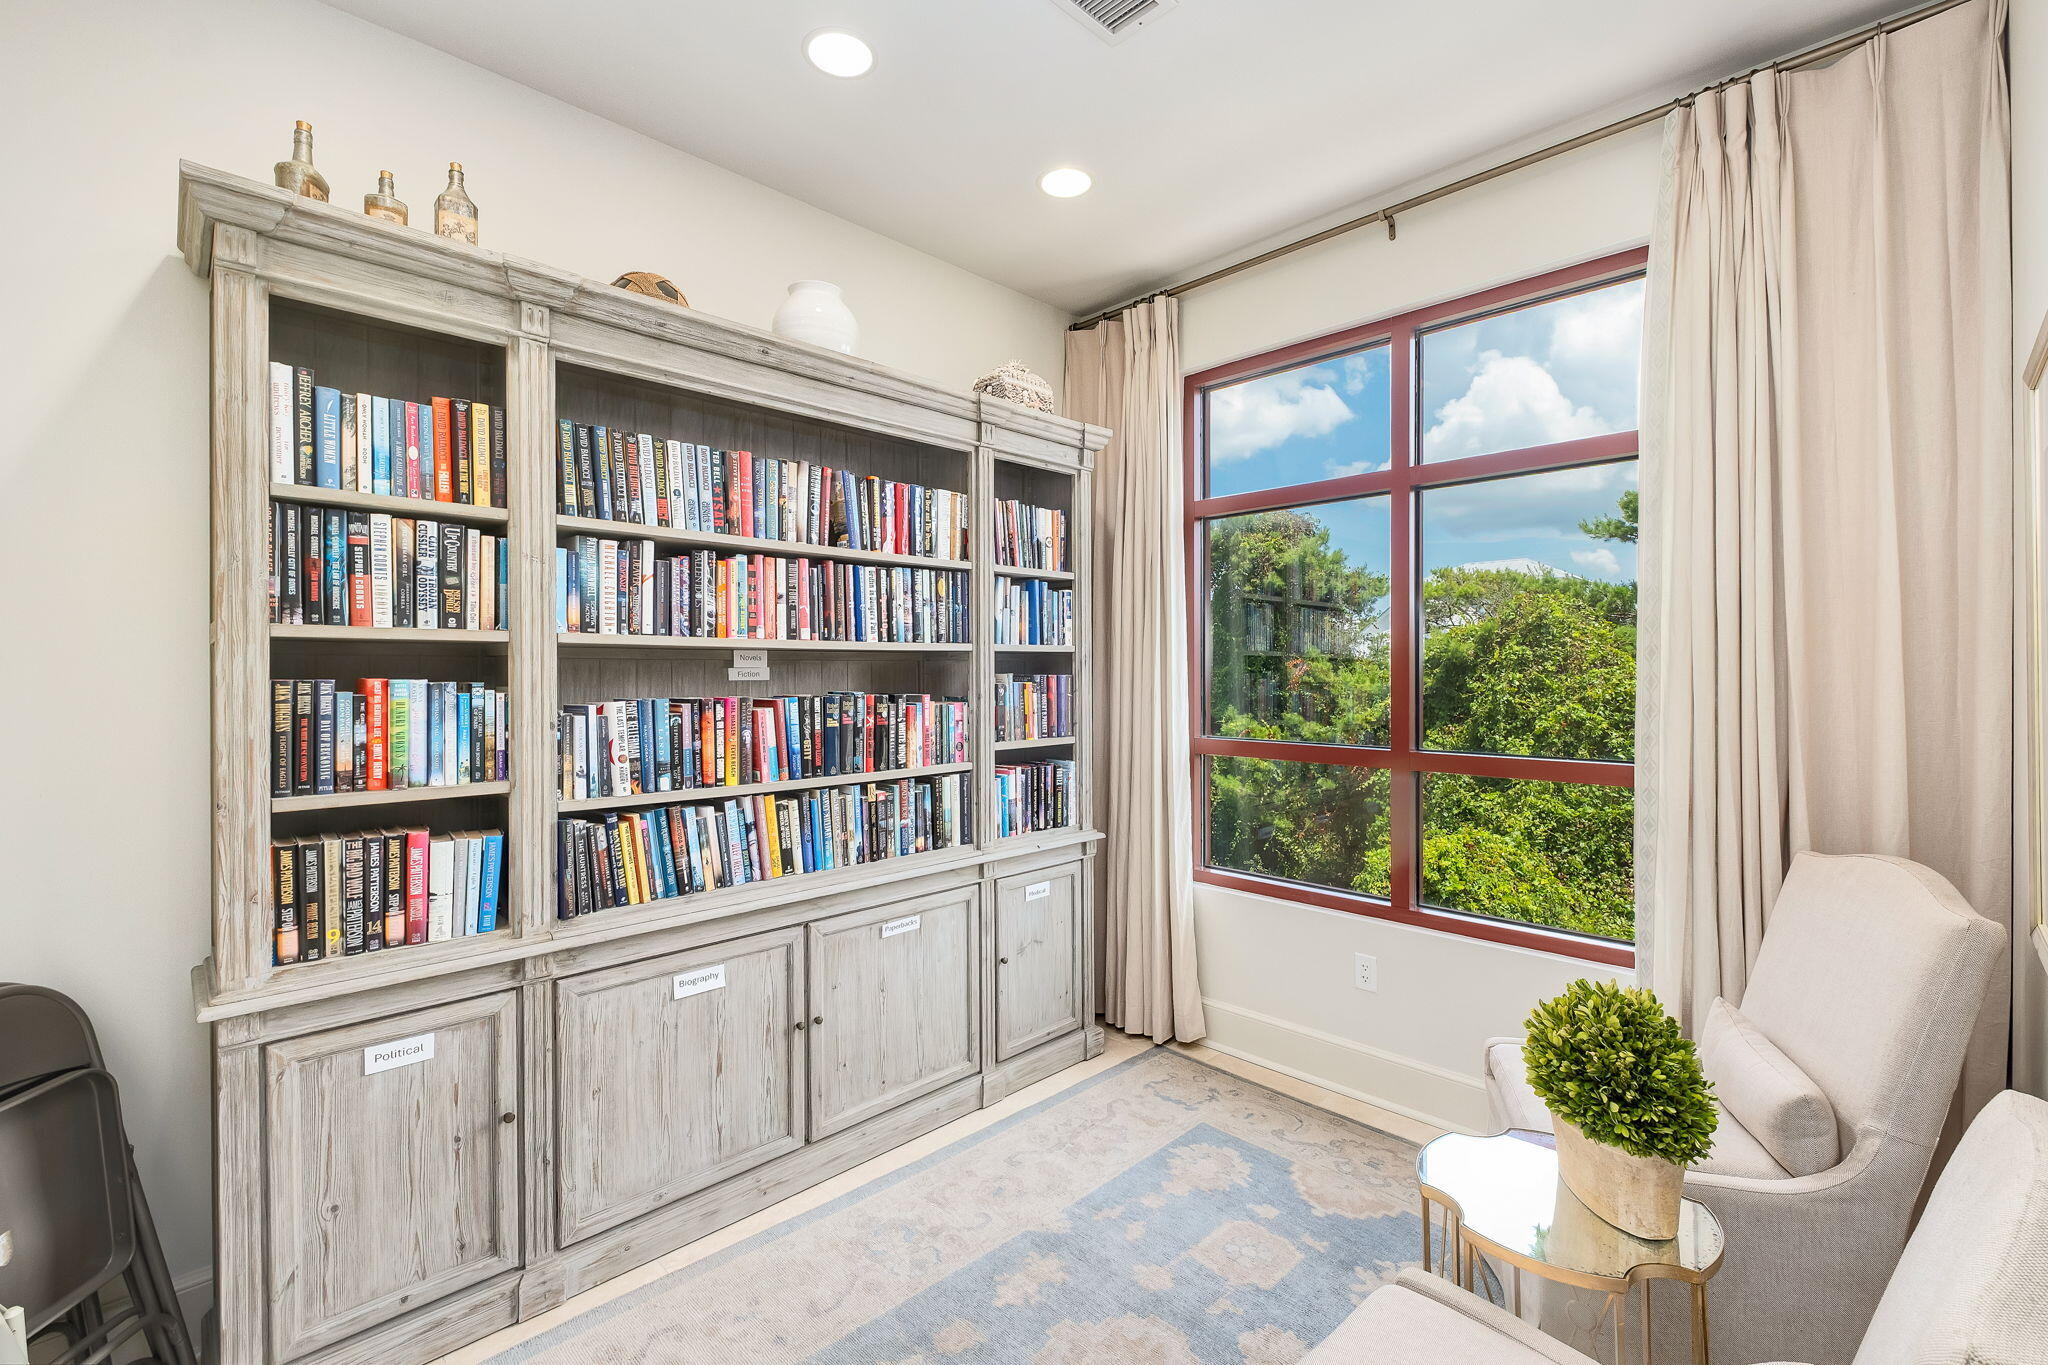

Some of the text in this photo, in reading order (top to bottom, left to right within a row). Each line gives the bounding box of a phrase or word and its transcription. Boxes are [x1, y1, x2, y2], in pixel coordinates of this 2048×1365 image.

[297, 374, 311, 443] JEFFREY ARCHER
[324, 414, 336, 464] LITTLE WOMEN
[477, 418, 486, 465] DAVID BALDACCI
[494, 410, 504, 459] DAVID BALDACCI
[562, 431, 571, 449] DAVID
[579, 428, 588, 447] DAVID
[581, 448, 591, 479] BALDACCI
[613, 439, 623, 460] DAVID
[628, 443, 637, 464] DAVID
[641, 436, 653, 488] DAVID BALDACCI
[655, 449, 663, 467] DAVID
[712, 451, 720, 464] TED
[564, 452, 573, 482] BALDACCI
[615, 462, 626, 496] BALDACCI
[630, 465, 639, 499] BALDACCI
[657, 468, 666, 497] BALDACCI
[287, 510, 295, 531] MICHAEL
[713, 496, 724, 526] TSAR
[374, 522, 387, 552] STEPHEN
[418, 524, 427, 558] CUSSLER
[429, 536, 437, 558] CLIVE
[354, 546, 363, 577] STEPHEN
[374, 554, 387, 580] COONTS
[587, 538, 596, 597] PATRICIA CORNWELL
[604, 544, 615, 580] MICHAEL
[356, 580, 364, 609] COONTS
[418, 577, 427, 612] ODYSSEY
[429, 578, 437, 609] TROJAN
[320, 682, 333, 694] JACK
[737, 670, 760, 678] Fiction
[275, 684, 290, 701] JACK
[320, 695, 333, 715] HIGGINS
[275, 703, 290, 732] HIGGINS
[320, 720, 330, 731] DAY
[626, 703, 640, 758] FAYE KELLERMAN
[280, 758, 287, 766] OF
[320, 743, 330, 780] RECKONING
[897, 744, 906, 764] NINJA
[279, 768, 287, 788] EAGLES
[675, 810, 683, 844] BARRACUDA
[280, 850, 293, 870] JAMES
[410, 847, 423, 866] JAMES
[486, 842, 496, 898] JAMES PATTERSON
[613, 830, 626, 889] McNALLY'S DARE
[280, 870, 294, 905] PATTERSON
[346, 849, 363, 899] BIG BAD WOLF
[369, 842, 379, 912] JAMES PATTERSON
[410, 866, 423, 895] PATTERSON
[282, 908, 293, 922] STEP
[346, 909, 363, 948] PATTERSON
[885, 920, 918, 932] Paperbacks
[679, 972, 720, 988] Biography
[375, 1043, 424, 1063] Political
